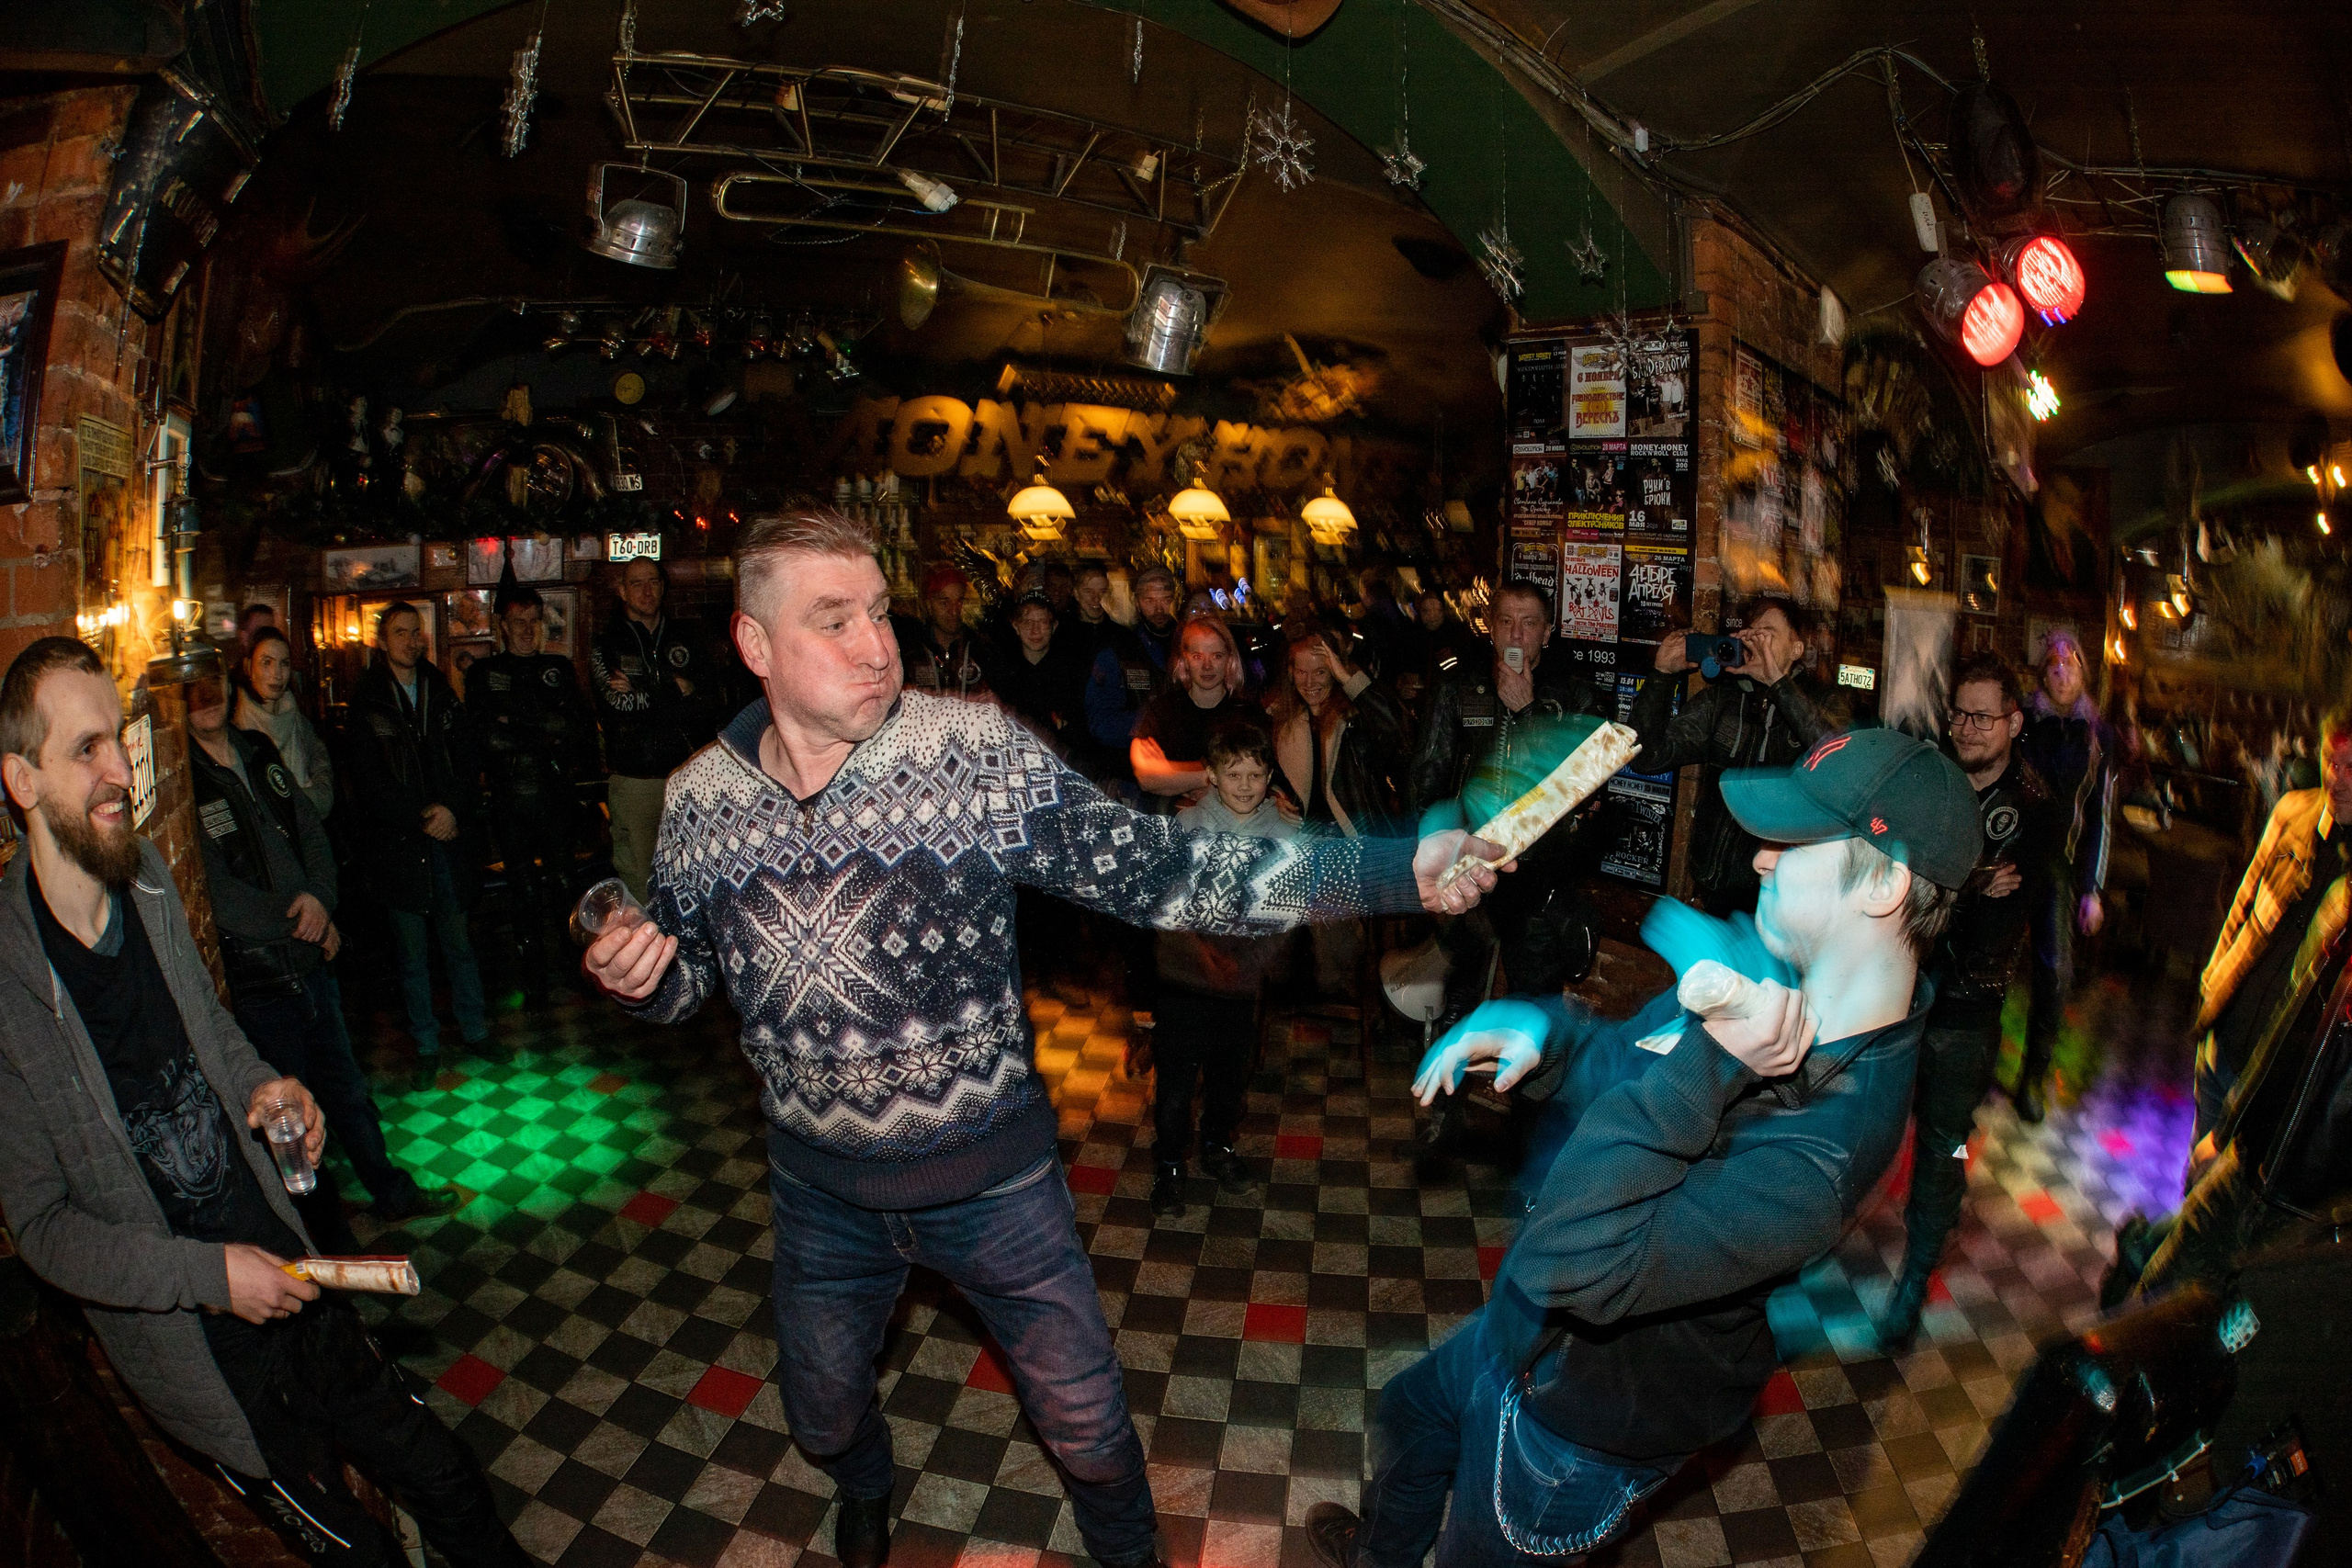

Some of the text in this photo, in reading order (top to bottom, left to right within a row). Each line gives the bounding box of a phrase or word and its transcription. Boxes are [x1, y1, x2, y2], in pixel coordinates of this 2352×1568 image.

[1577, 371, 1621, 383] 6 НОЯБРЯ
[1609, 443, 1626, 451] МАРТА
[1644, 492, 1671, 506] БРЮКИ
[1568, 513, 1624, 522] ПРИКЛЮЧЕНИЯ
[1629, 510, 1645, 523] 16
[1567, 520, 1624, 529] ЭЛЕКТРОНИКОВ
[613, 540, 658, 555] T60 DRB
[1566, 563, 1619, 577] HALLOWEEN
[1628, 579, 1678, 605] АПРЕЛЯ
[1725, 617, 1743, 628] since
[1588, 649, 1616, 665] 1993
[1840, 671, 1871, 686] 5ATH072
[1634, 801, 1662, 825] TWISTER
[1615, 851, 1649, 864] ROCKER
